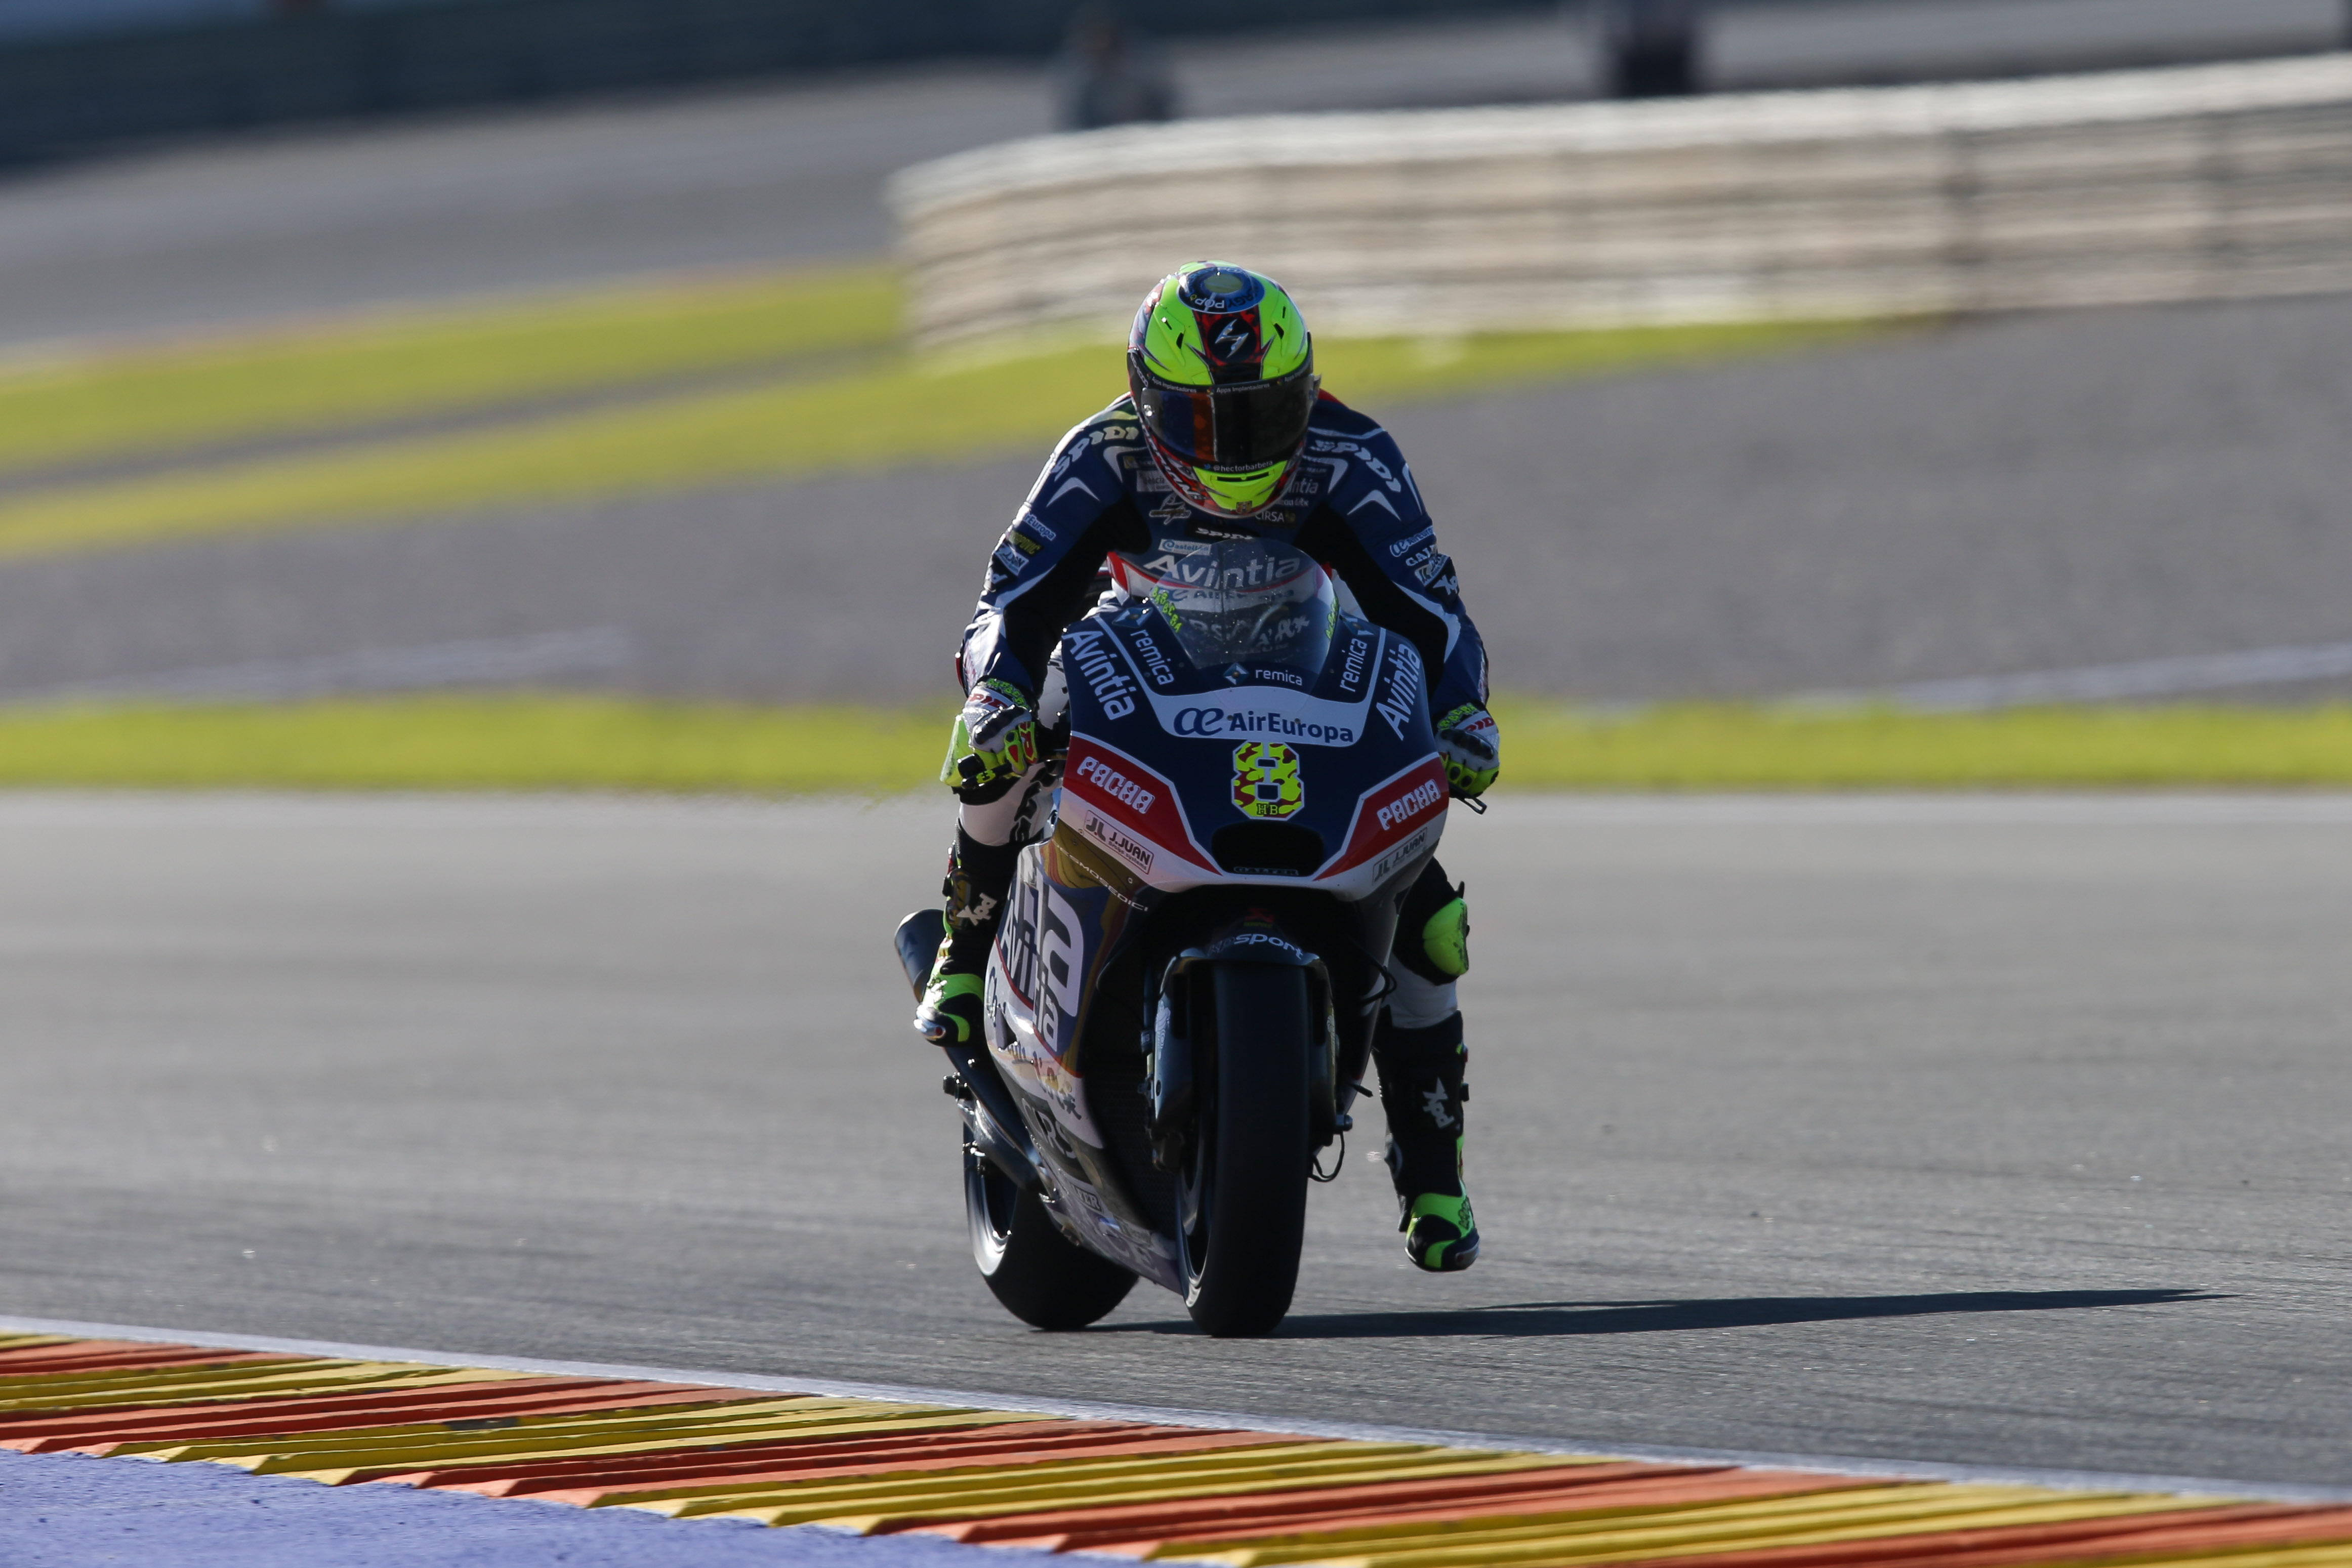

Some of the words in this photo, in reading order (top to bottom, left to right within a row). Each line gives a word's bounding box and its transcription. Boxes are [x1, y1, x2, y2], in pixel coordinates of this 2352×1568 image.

[1232, 383, 1270, 393] Implantadores
[1213, 460, 1273, 472] @hectorbarbera
[1062, 631, 1137, 721] Avintia
[1130, 630, 1174, 685] remica
[1255, 669, 1303, 686] remica
[1340, 638, 1367, 692] remica
[1376, 643, 1420, 741] Avintia
[1229, 711, 1354, 744] AirEuropa
[1077, 756, 1156, 814] PACHA
[1231, 739, 1305, 821] 8
[1377, 779, 1441, 831] PACHA
[1108, 831, 1151, 865] J.JUAN
